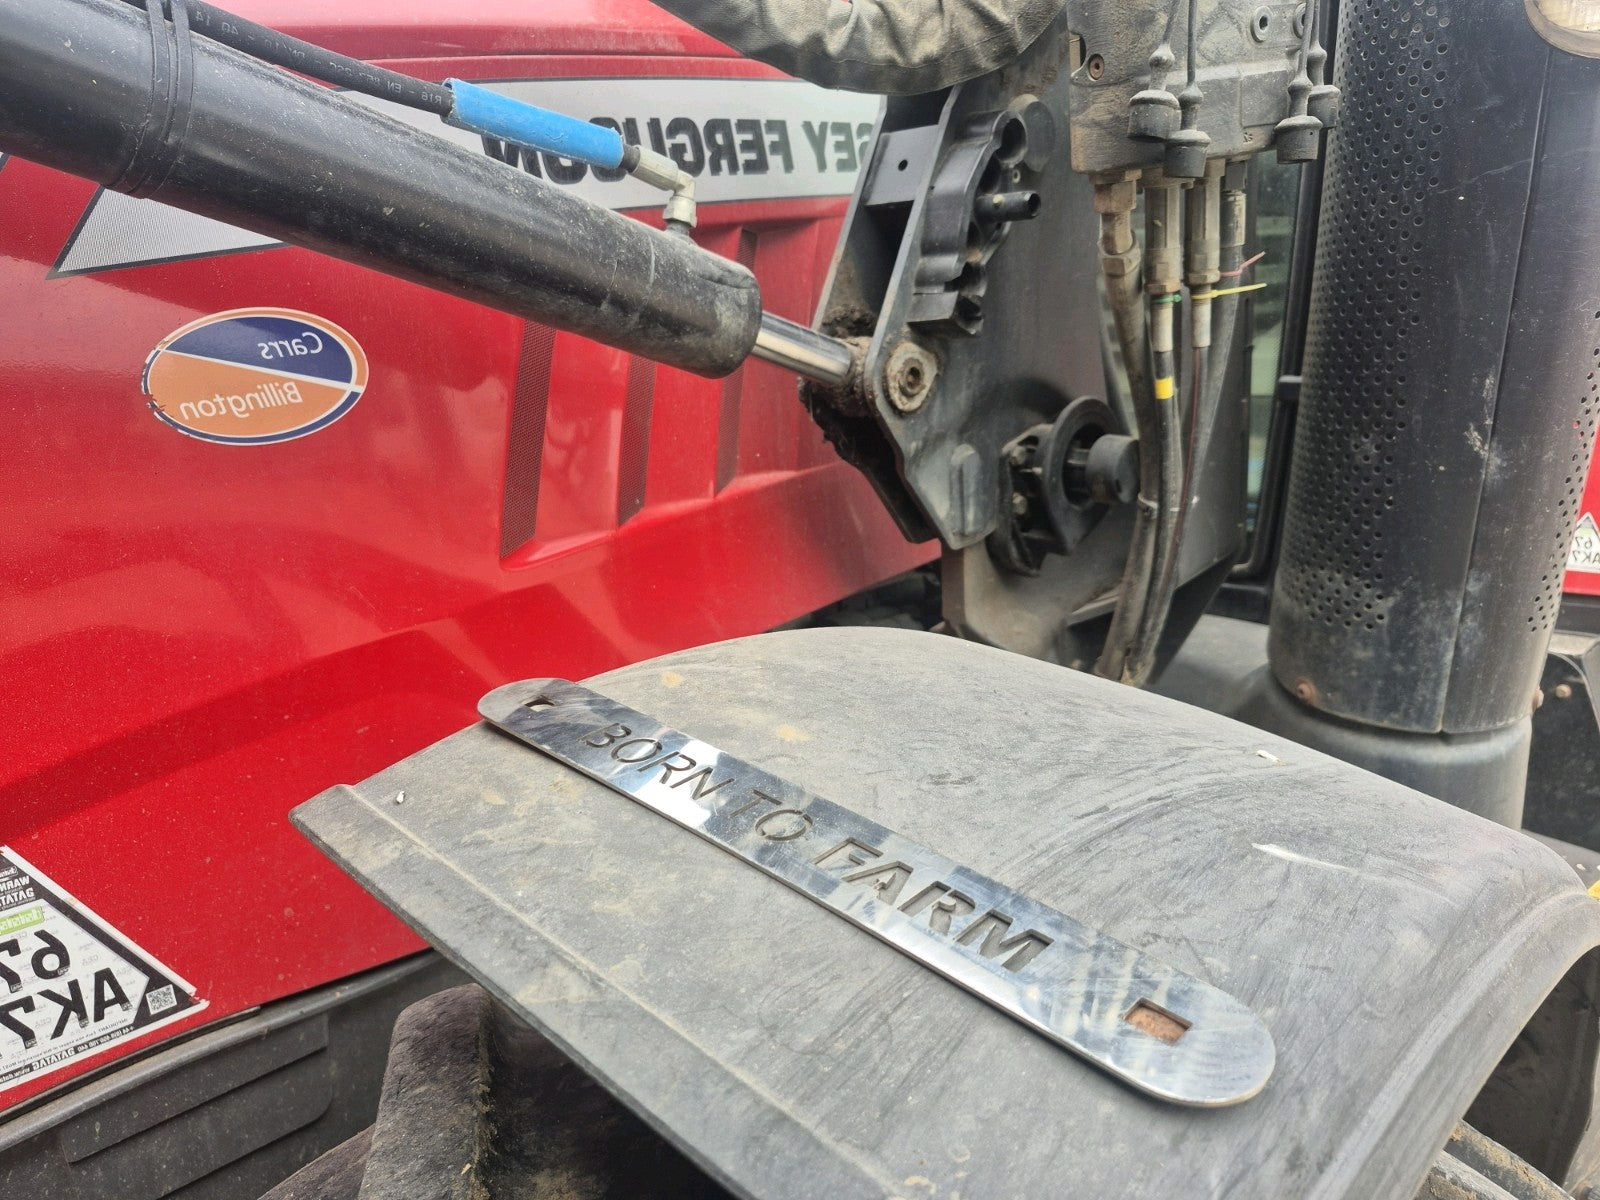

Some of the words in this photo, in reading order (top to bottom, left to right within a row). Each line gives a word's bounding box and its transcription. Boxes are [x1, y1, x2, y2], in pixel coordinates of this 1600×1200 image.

[577, 722, 736, 803] BORN
[728, 789, 815, 842] TO
[811, 836, 1056, 974] FARM
